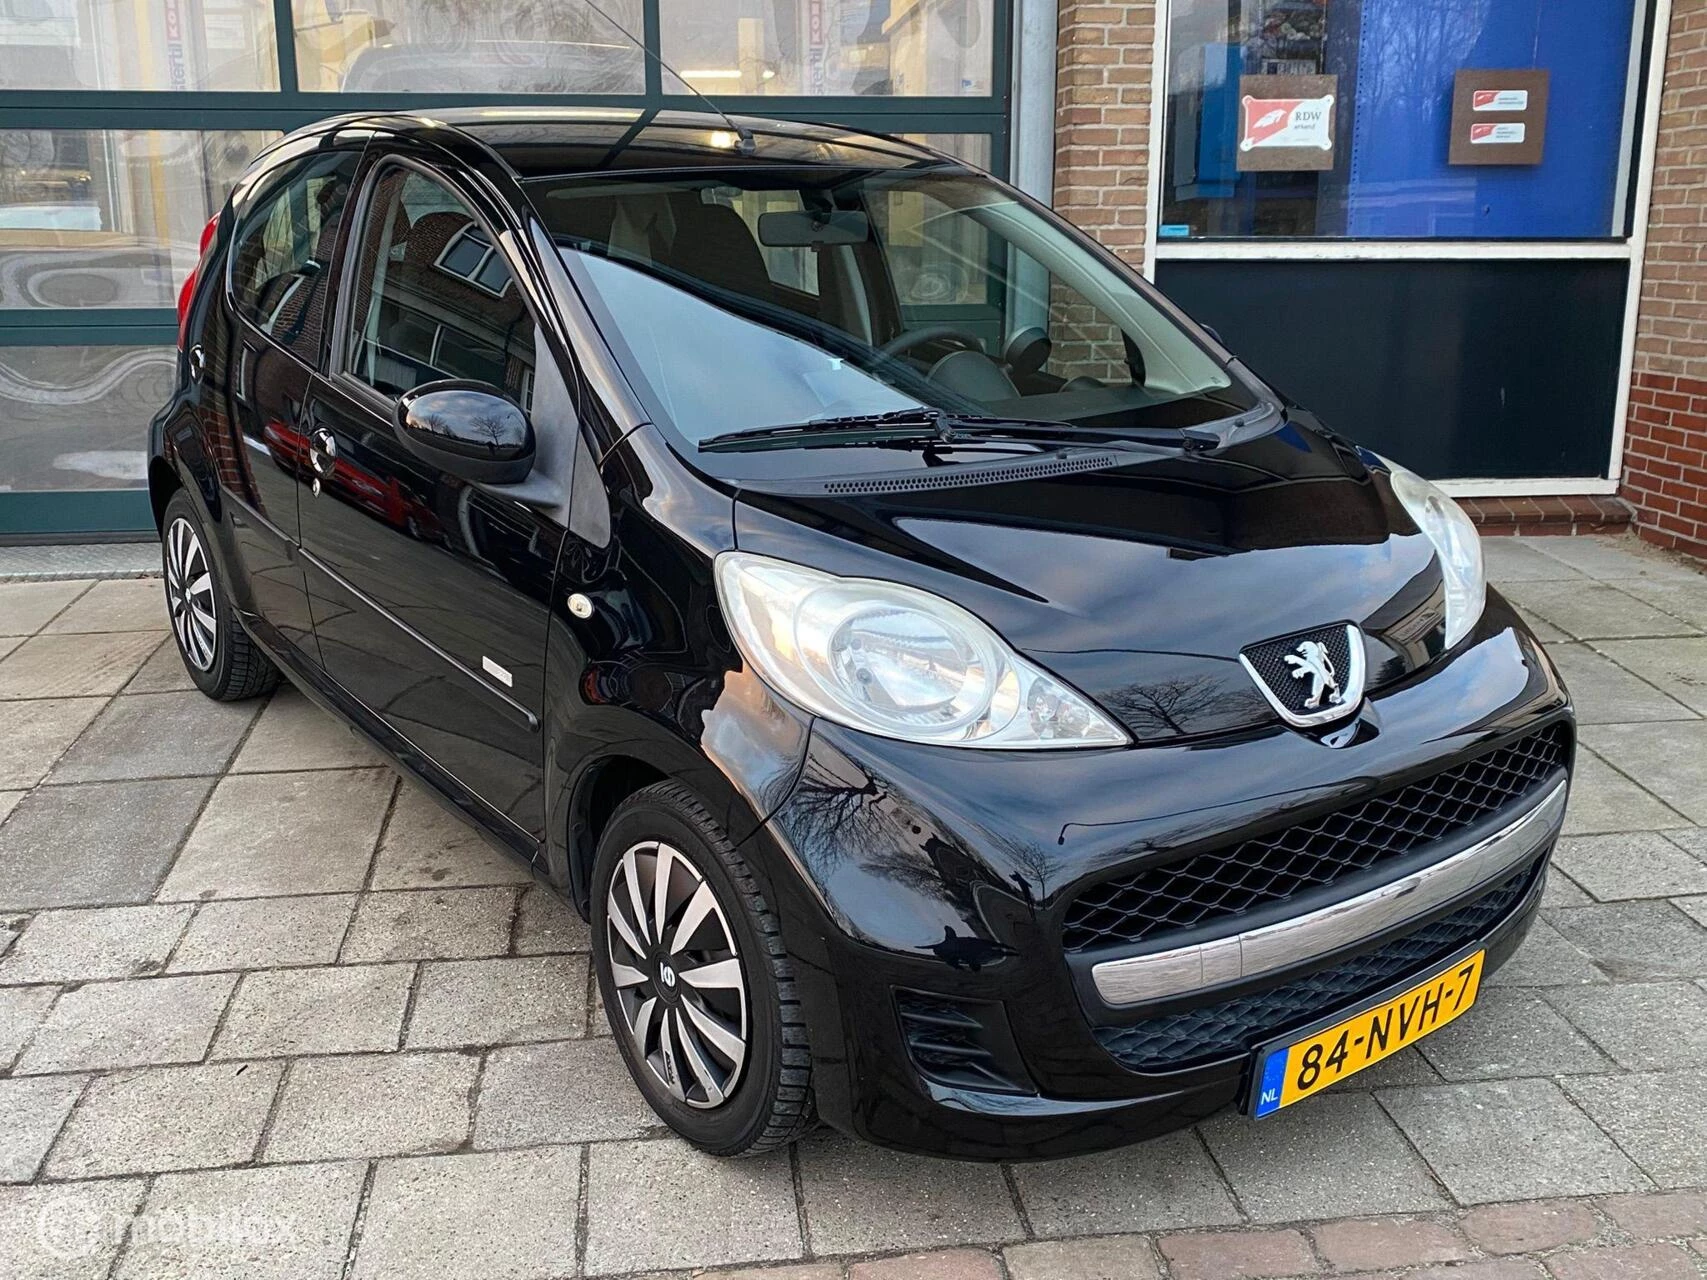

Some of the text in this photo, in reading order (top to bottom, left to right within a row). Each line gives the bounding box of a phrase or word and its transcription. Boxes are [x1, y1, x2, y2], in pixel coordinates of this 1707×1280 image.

[1295, 111, 1322, 121] RDW
[1296, 963, 1475, 1091] 84-NVH-7
[1260, 1090, 1279, 1106] NL
